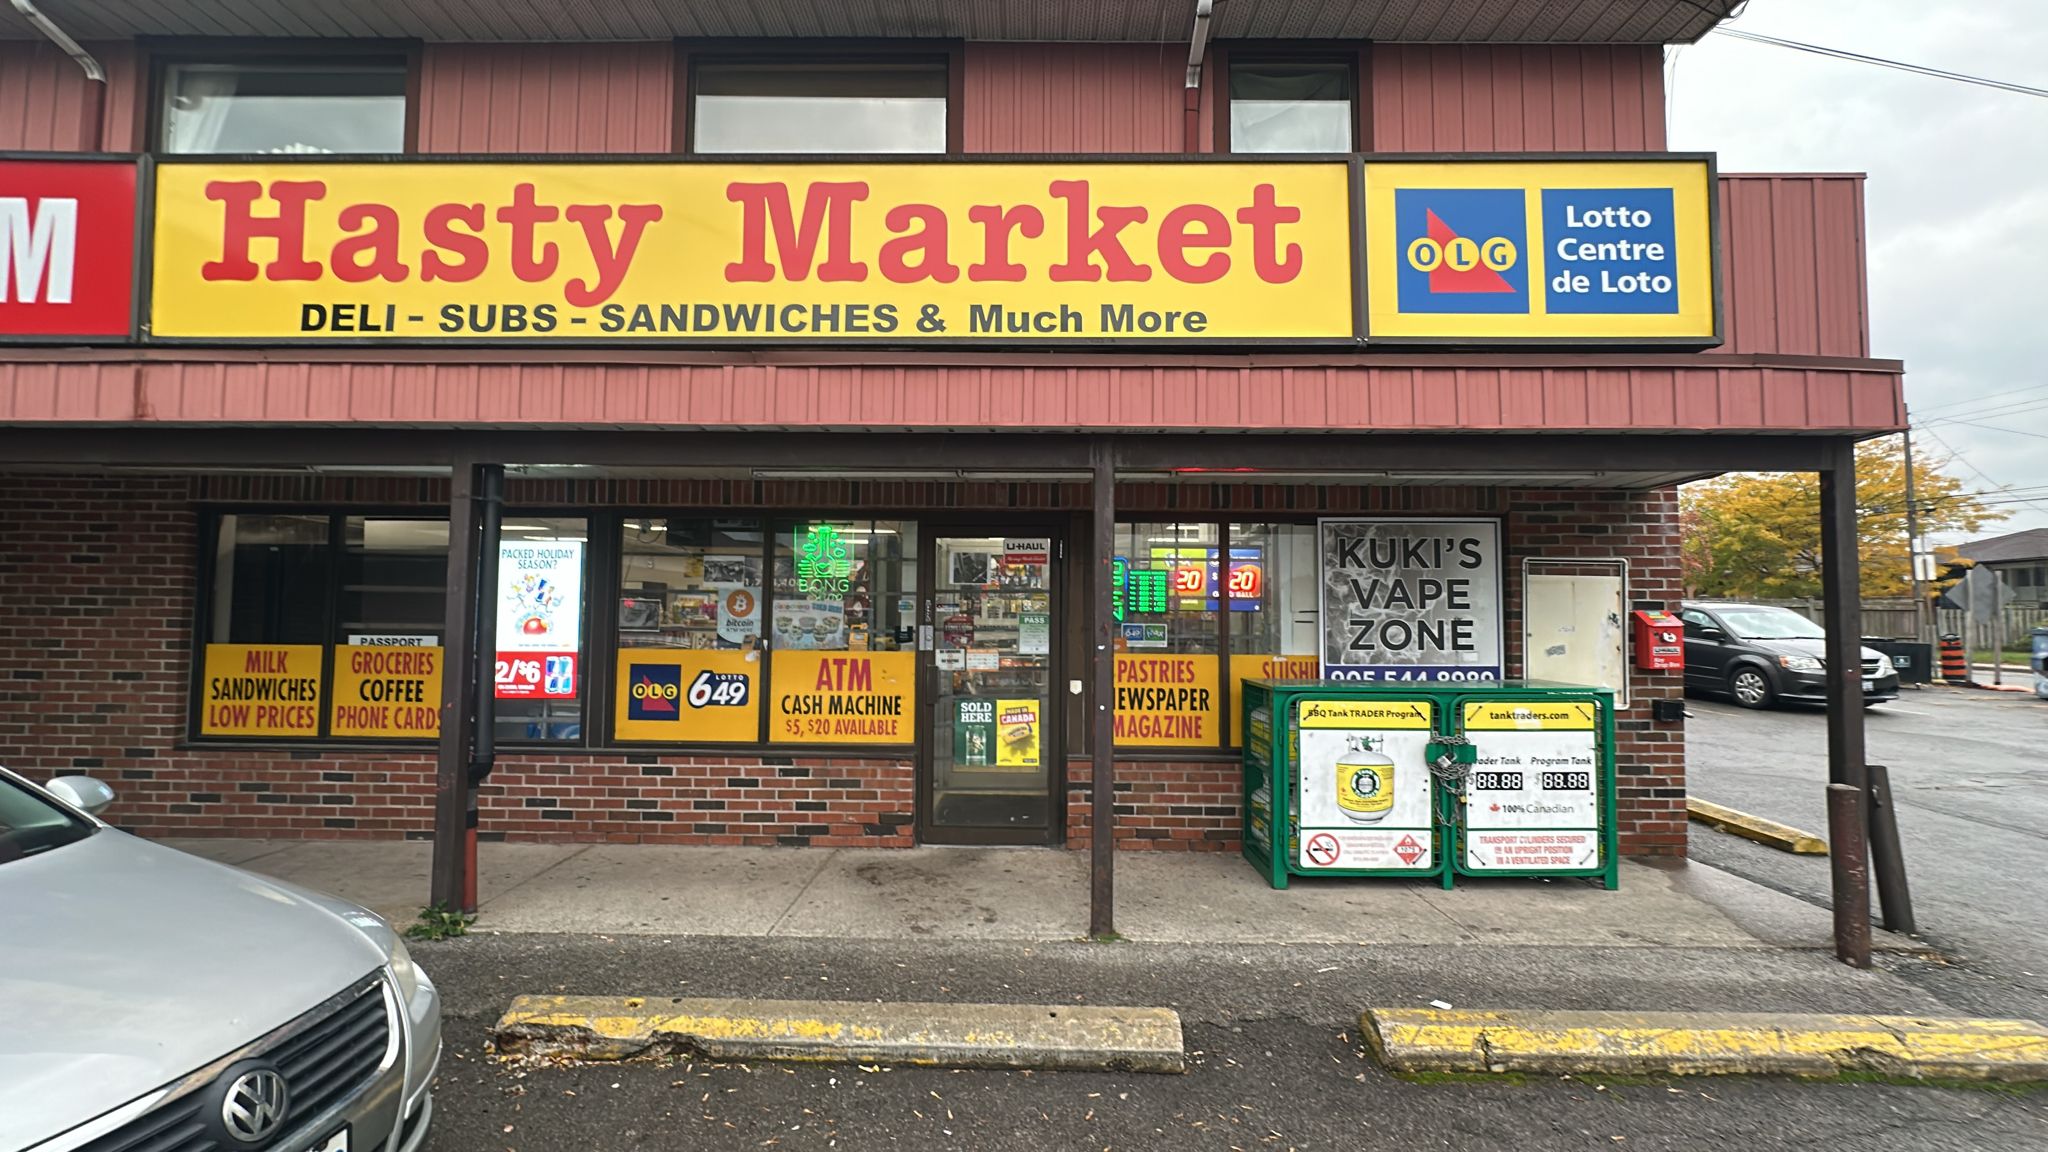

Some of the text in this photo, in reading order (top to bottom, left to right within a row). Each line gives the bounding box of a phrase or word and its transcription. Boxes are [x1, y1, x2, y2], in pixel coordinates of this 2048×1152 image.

[1567, 205, 1652, 228] Lotto
[202, 179, 1302, 307] Hasty Market
[1557, 238, 1665, 261] Centre
[1415, 243, 1507, 265] OLG
[1552, 270, 1672, 293] de Loto
[300, 304, 396, 331] DELI
[438, 304, 558, 332] SUBS
[600, 304, 899, 332] SANDWICHES
[916, 304, 947, 333] &
[970, 304, 1083, 332] Much
[1101, 304, 1208, 332] More
[502, 549, 574, 559] PACKED HOLIDAY
[1338, 537, 1483, 570] KUKI'S
[518, 560, 558, 569] SEASON?
[798, 579, 850, 592] BONG
[1229, 571, 1255, 590] 20
[1350, 578, 1471, 610] VAPE
[726, 618, 754, 627] bitcoin
[1349, 619, 1475, 651] ZONE
[245, 650, 289, 673] MILK
[352, 651, 434, 675] GROCERIES
[1118, 659, 1195, 683] PASTRIES
[815, 658, 873, 691] ATM
[211, 677, 317, 701] SANDWICHES
[359, 679, 424, 702] COFFEE
[635, 685, 675, 697] OLG
[781, 694, 901, 715] CASH MACHINE
[960, 702, 992, 713] SOLD
[1328, 709, 1348, 718] Tank
[1350, 709, 1385, 718] TRADER
[209, 705, 315, 728] LOW PRICES
[336, 705, 389, 729] PHONE
[960, 713, 992, 723] HERE
[1001, 713, 1035, 724] CANADA
[1113, 714, 1202, 738] MAGAZINE
[1489, 711, 1569, 720] tanktraders.com
[786, 719, 898, 738] $5, $20 AVAILABLE
[1500, 756, 1521, 765] Tank
[1530, 756, 1592, 767] Program Tank
[1502, 804, 1575, 813] 100% Canadian
[1479, 836, 1517, 844] TRANSPORT
[1556, 836, 1586, 844] SECURED
[1514, 846, 1542, 854] UPRIGHT
[1543, 846, 1574, 854] POSITION
